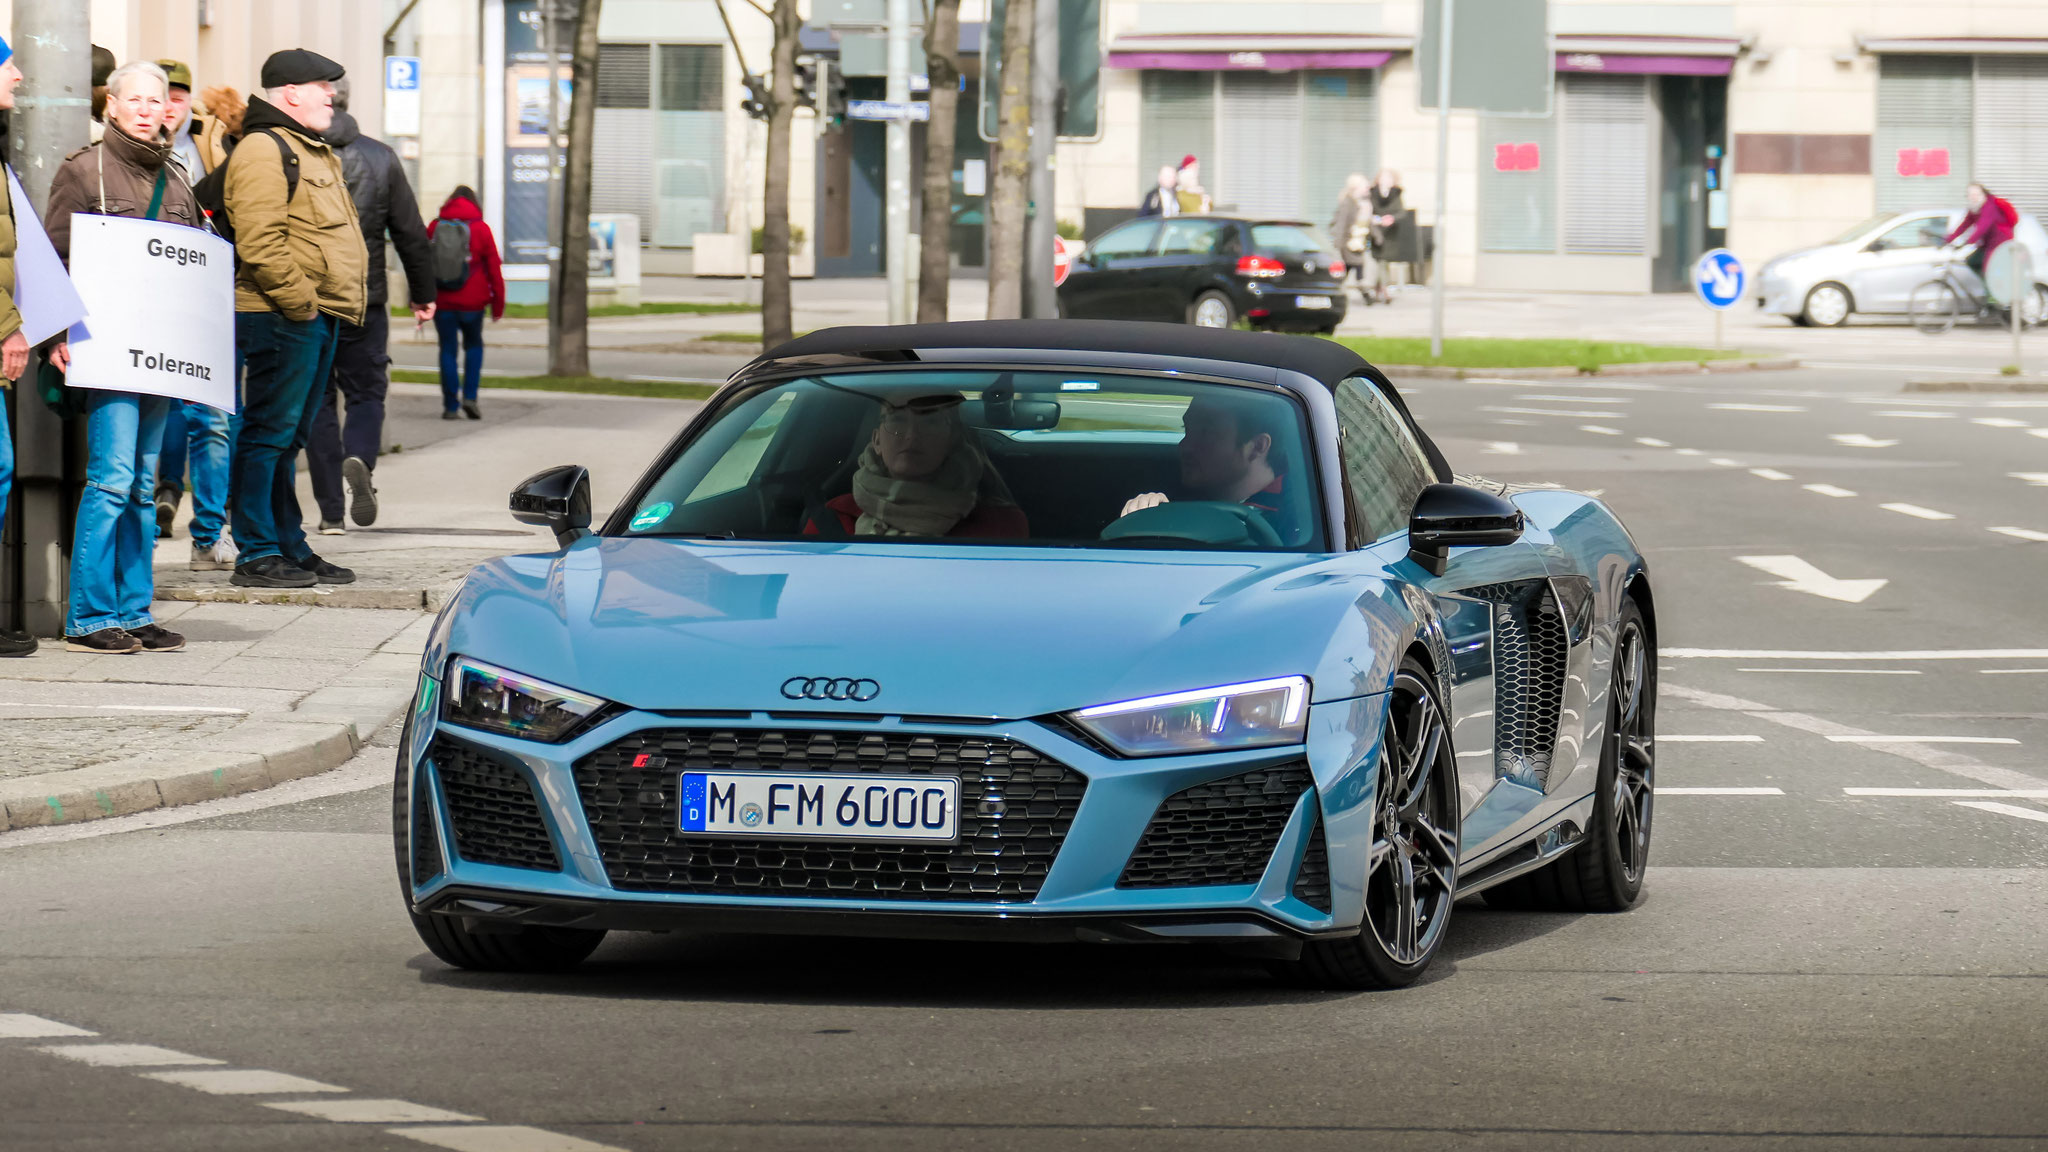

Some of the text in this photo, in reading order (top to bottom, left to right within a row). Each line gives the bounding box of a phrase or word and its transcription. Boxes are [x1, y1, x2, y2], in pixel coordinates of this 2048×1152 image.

[390, 61, 412, 89] P
[147, 238, 207, 267] Gegen
[129, 348, 211, 381] Toleranz
[689, 808, 699, 821] D
[708, 781, 947, 830] M FM 6000
